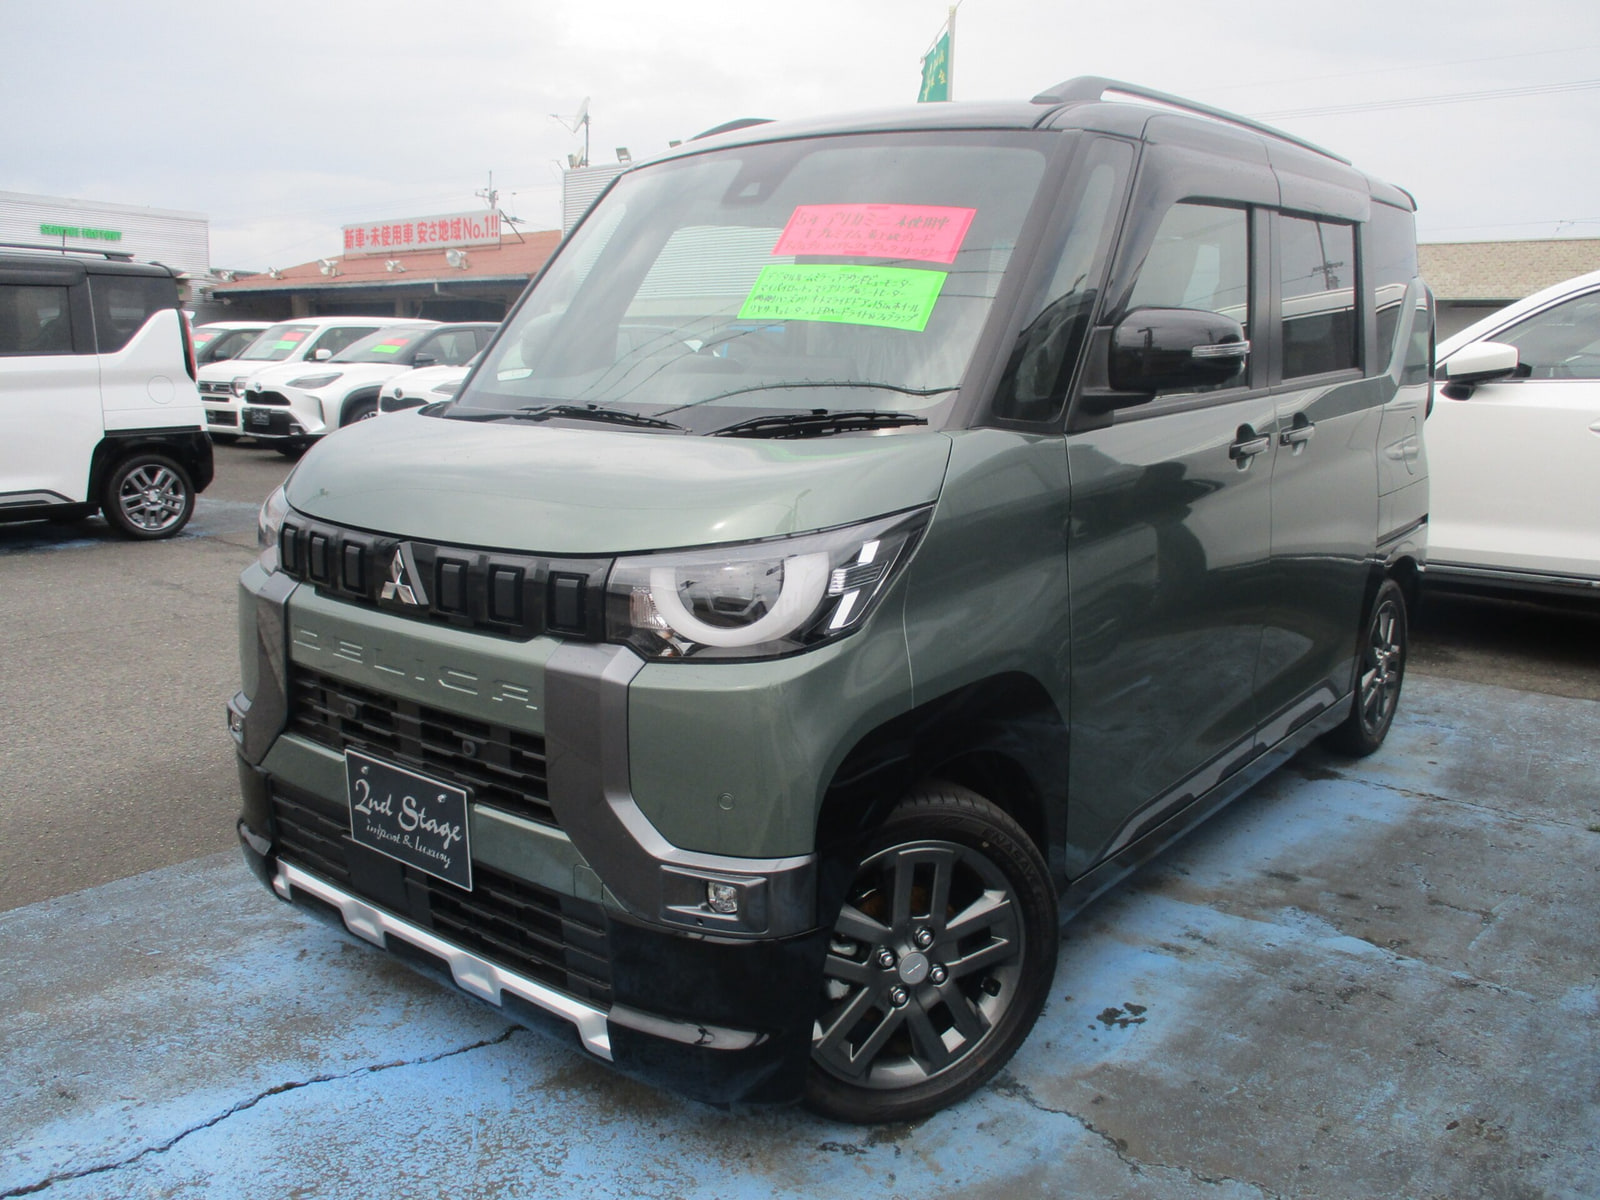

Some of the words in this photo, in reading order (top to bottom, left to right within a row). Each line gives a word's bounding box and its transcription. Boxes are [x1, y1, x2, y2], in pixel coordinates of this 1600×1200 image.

[344, 223, 414, 249] 新車・未使用車
[292, 625, 538, 711] DELICA
[354, 778, 393, 817] 2nd
[398, 796, 463, 850] Stage
[366, 819, 401, 845] import
[402, 834, 413, 849] &
[414, 835, 452, 869] luxury
